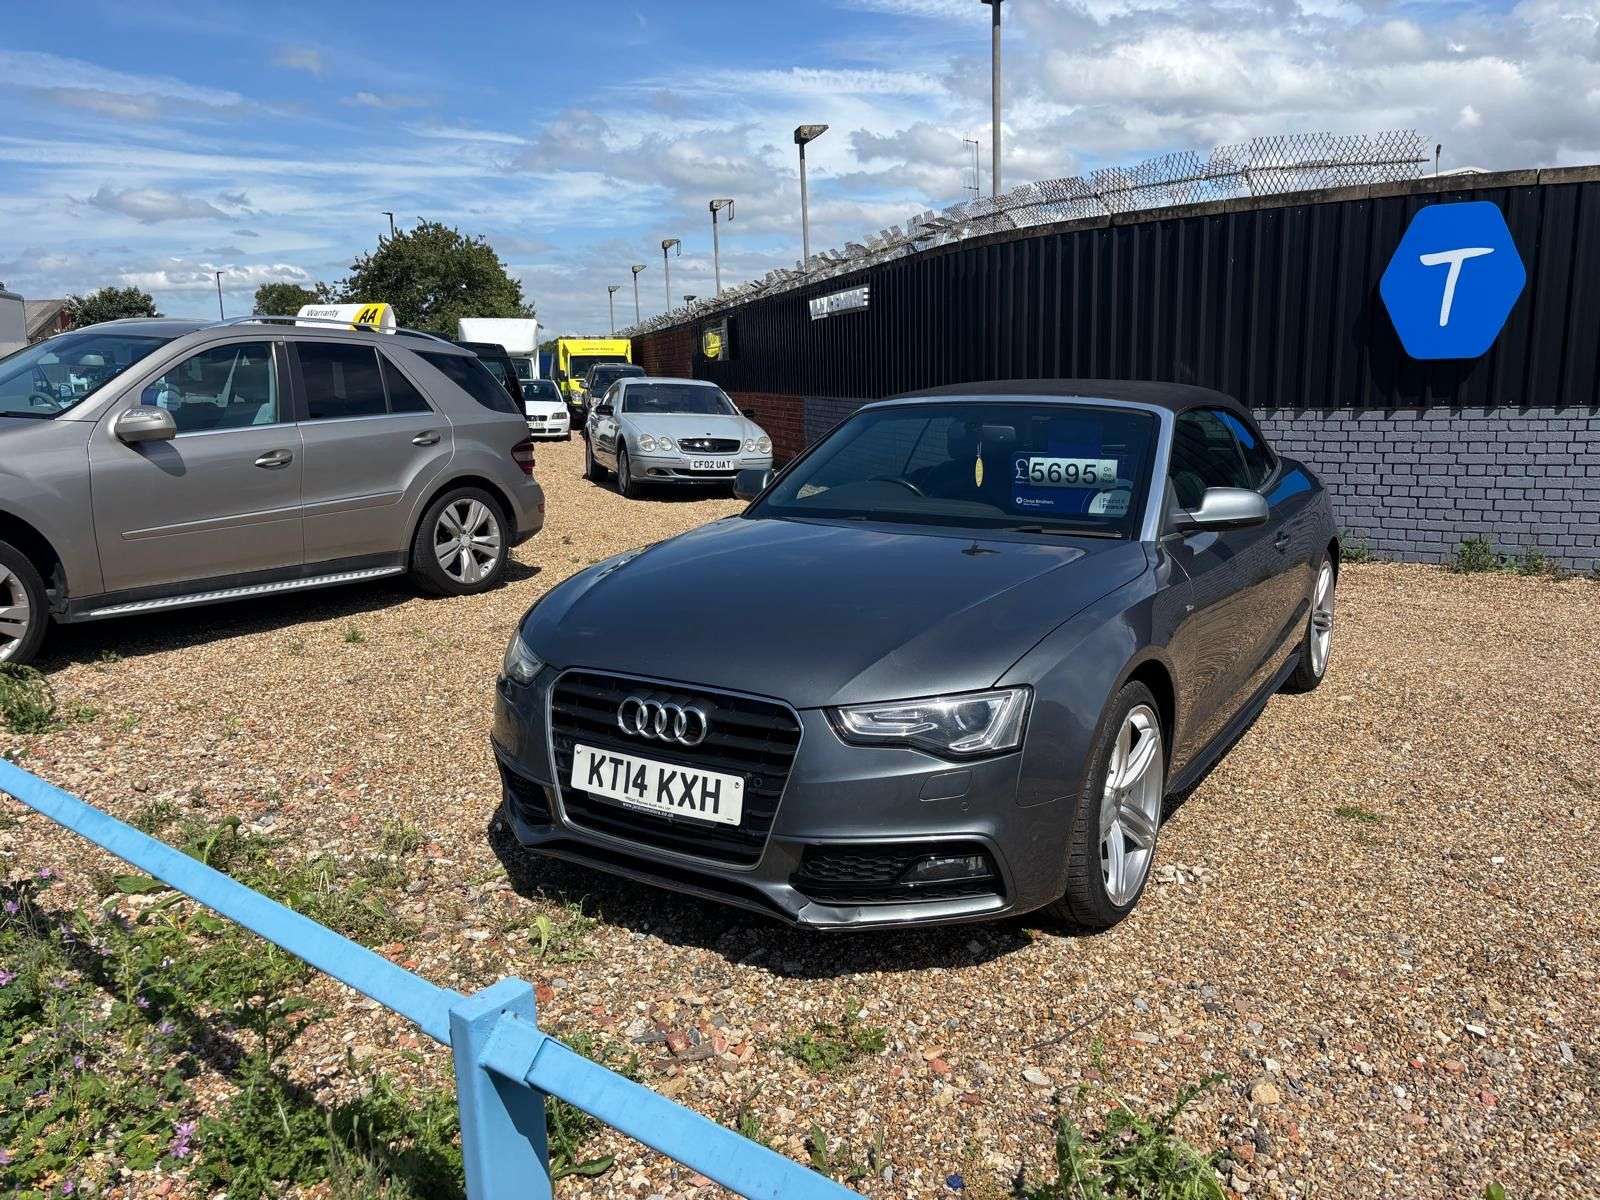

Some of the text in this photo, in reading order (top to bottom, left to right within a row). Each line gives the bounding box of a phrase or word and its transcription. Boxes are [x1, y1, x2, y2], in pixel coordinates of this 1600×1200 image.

[1420, 247, 1495, 327] T
[306, 308, 379, 323] Warranty AA
[693, 460, 731, 469] CF02 UAT
[588, 752, 722, 814] KT14 KXH
